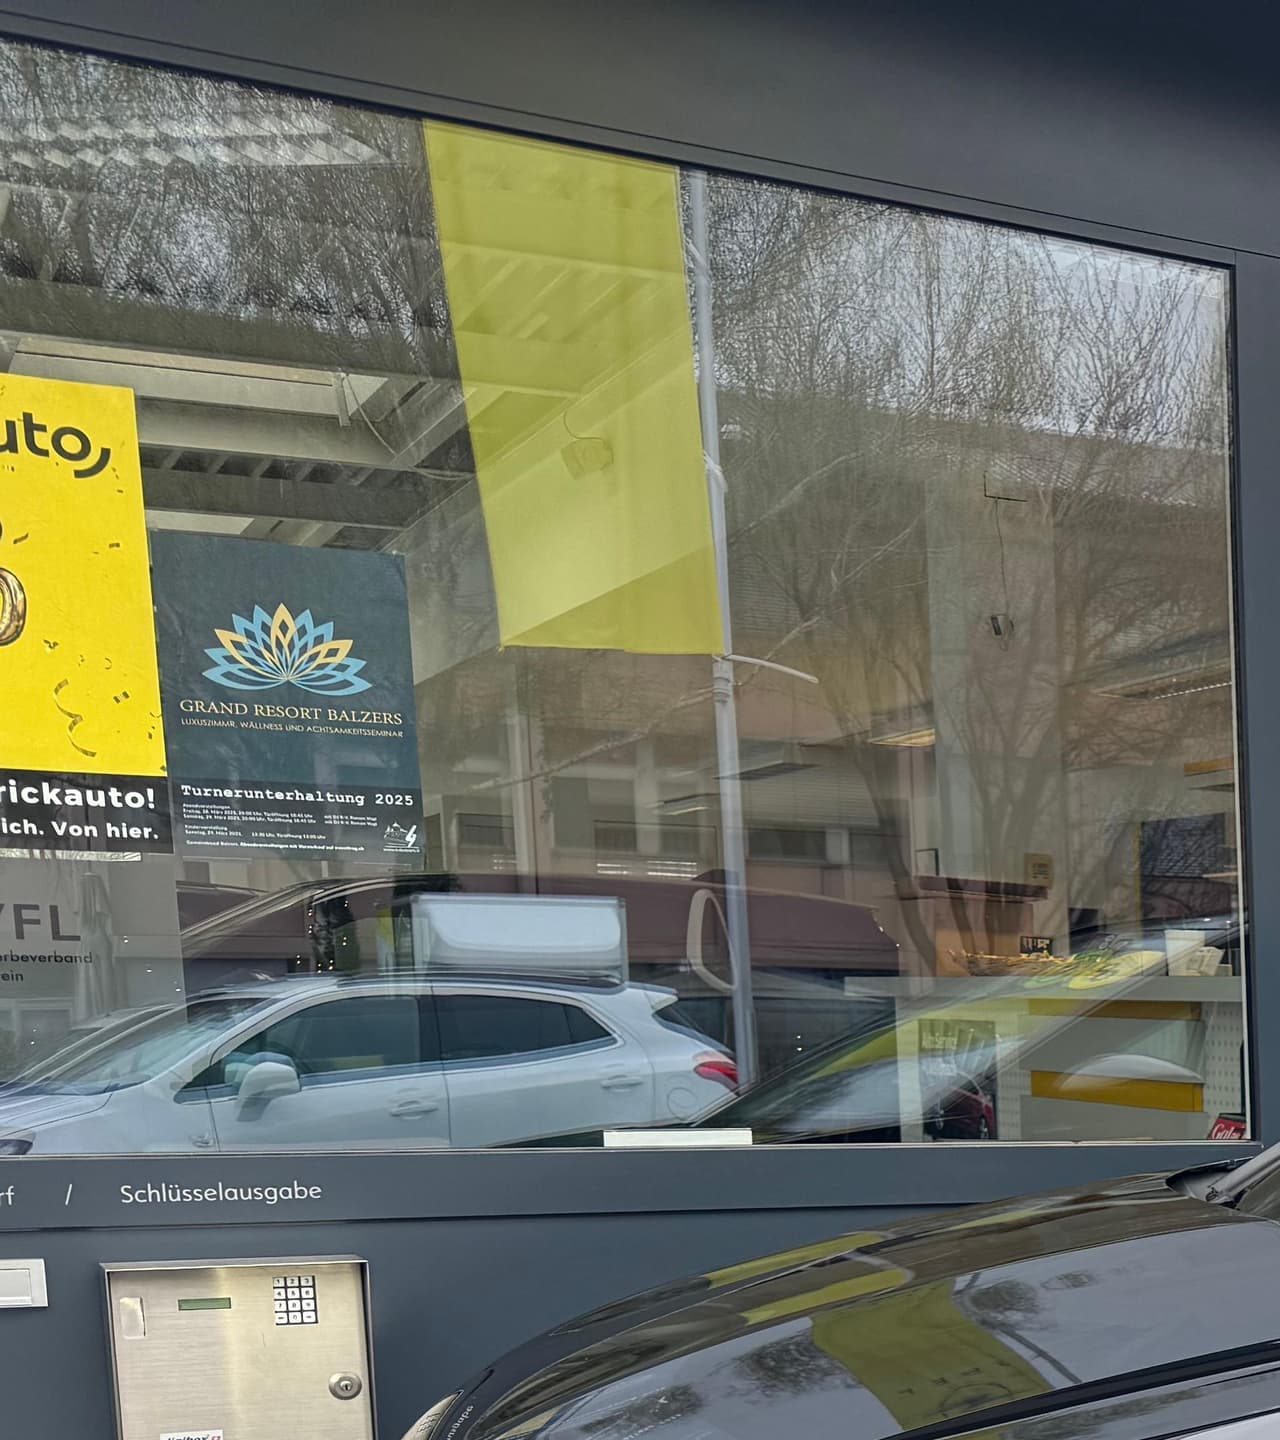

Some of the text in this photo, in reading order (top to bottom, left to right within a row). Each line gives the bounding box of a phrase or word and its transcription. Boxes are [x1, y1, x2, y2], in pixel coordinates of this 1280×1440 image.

[179, 699, 403, 726] GRAND RESORT BALZERS
[285, 724, 305, 733] UND
[180, 784, 414, 807] Turnerunterhaltung 2025
[51, 820, 98, 838] Von
[105, 822, 159, 840] hier.
[119, 1180, 322, 1204] Schlüsselausgabe
